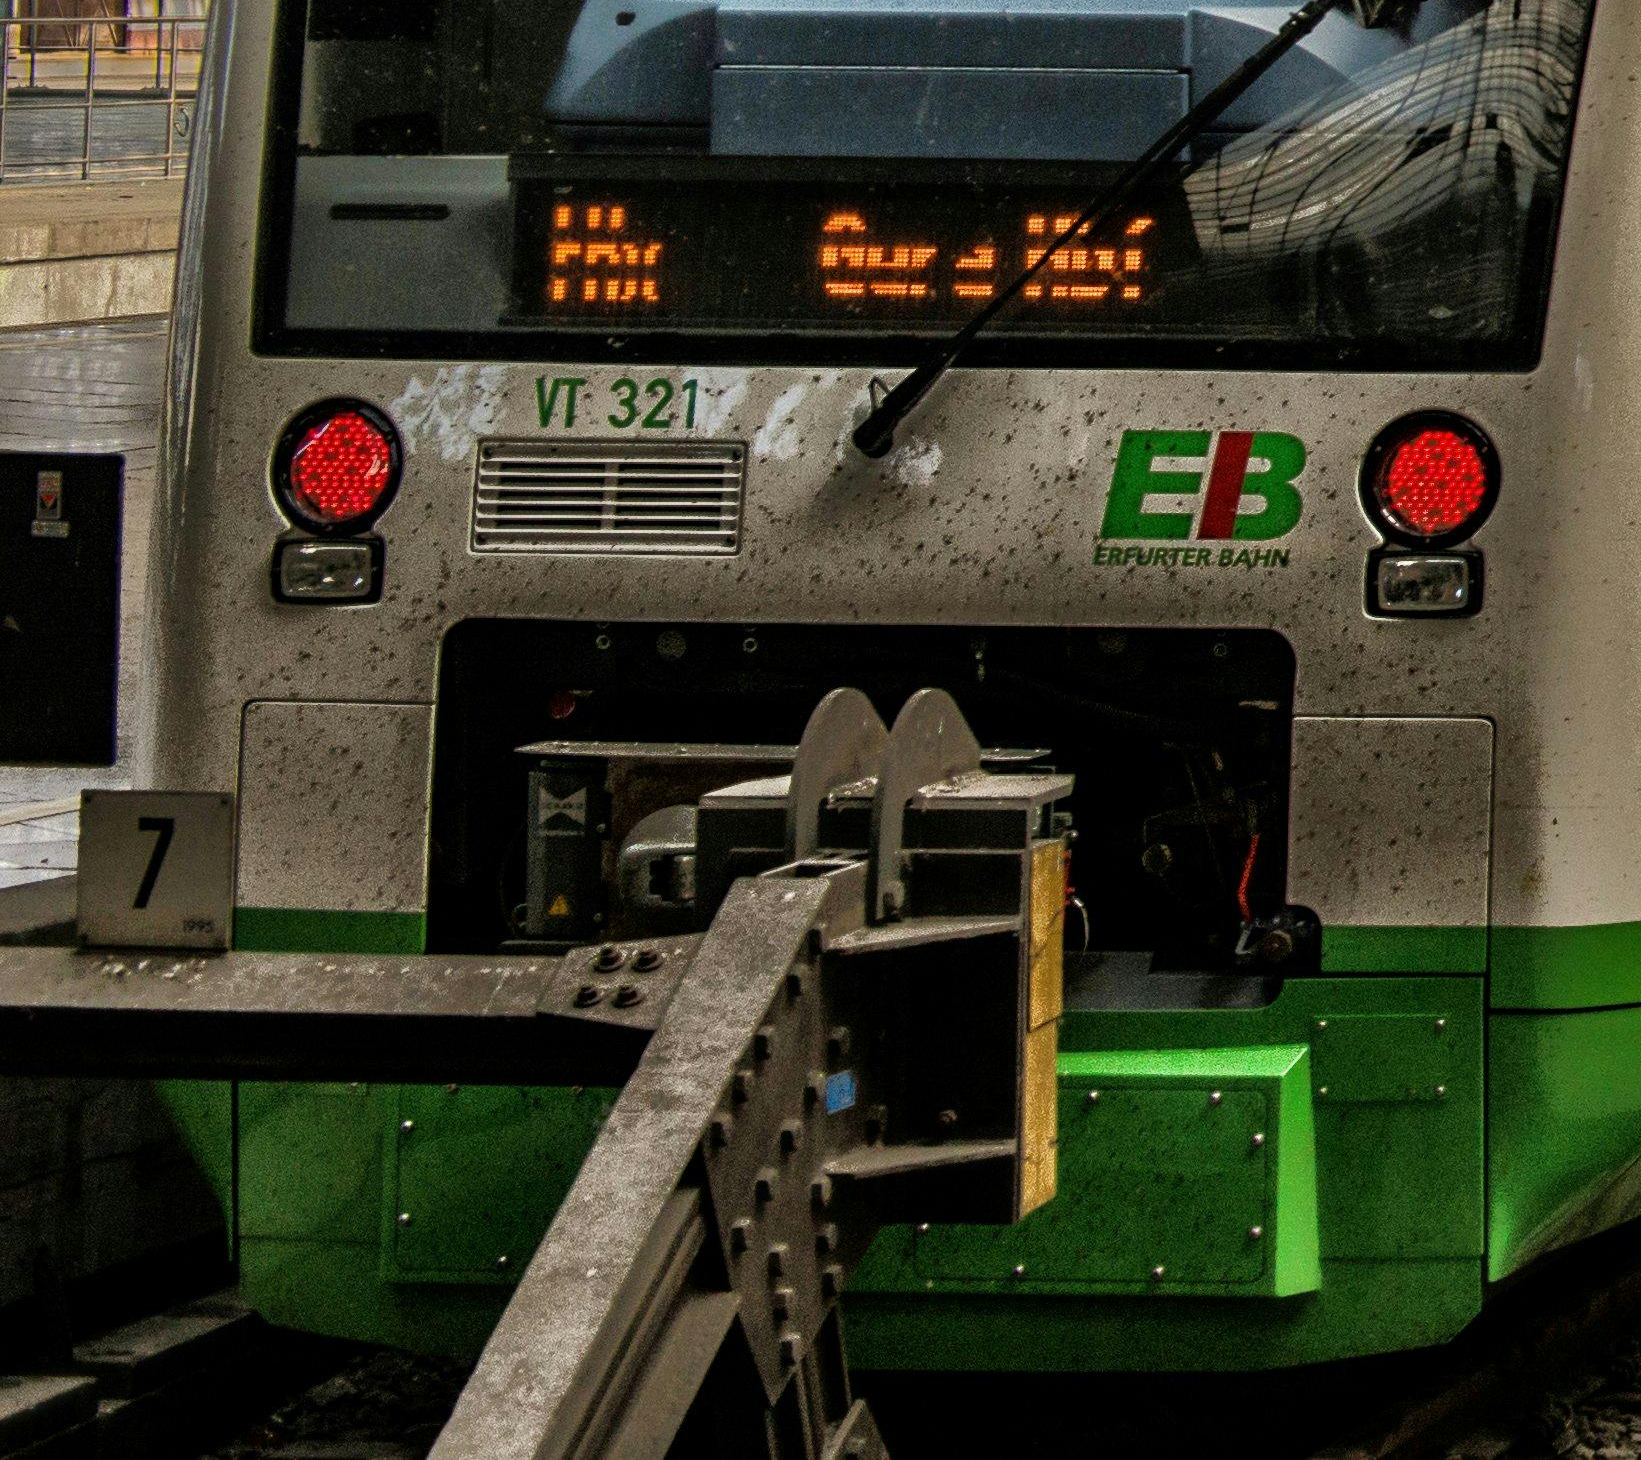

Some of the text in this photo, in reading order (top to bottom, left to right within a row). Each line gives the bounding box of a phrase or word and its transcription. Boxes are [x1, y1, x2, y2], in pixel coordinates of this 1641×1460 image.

[535, 377, 698, 430] VT 321
[1091, 546, 1291, 568] ERFURTER BAHN
[132, 817, 175, 909] 7
